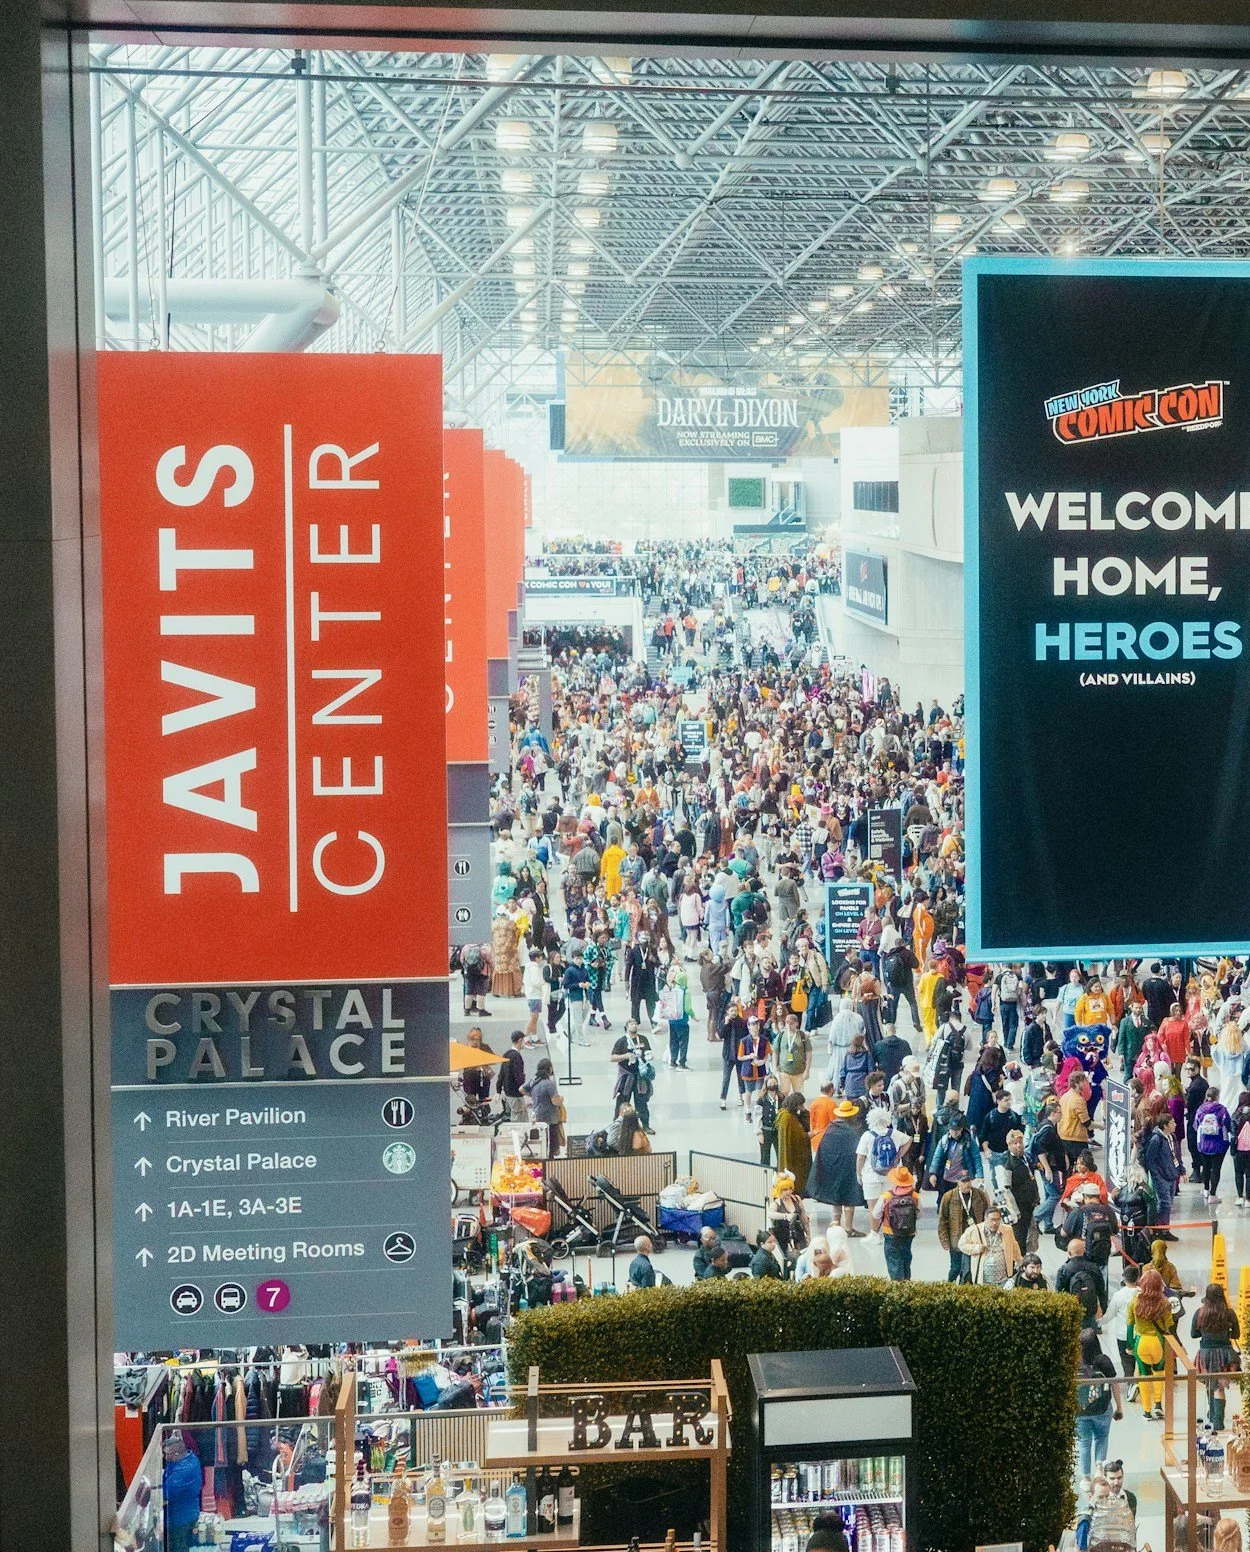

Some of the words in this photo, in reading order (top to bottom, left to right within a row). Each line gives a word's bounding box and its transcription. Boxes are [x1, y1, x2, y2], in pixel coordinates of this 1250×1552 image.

[656, 398, 729, 427] DARYL
[732, 398, 800, 428] DIXON
[1048, 393, 1078, 416] NEW
[1080, 383, 1118, 407] YORK
[1058, 393, 1156, 439] COMIC
[1159, 385, 1219, 423] CON
[677, 431, 698, 439] NOW
[699, 431, 750, 439] STREAMING
[679, 438, 735, 447] EXCLUSIVELY
[737, 438, 750, 447] ON
[558, 581, 577, 589] CON
[1053, 555, 1223, 602] HOME,
[1035, 620, 1243, 661] HEROES
[156, 443, 261, 896] JAVITS
[308, 440, 386, 897] CENTER
[1079, 671, 1119, 687] (AND
[1121, 671, 1197, 687] VILLAINS)
[145, 988, 406, 1035] CRYSTAL
[146, 1032, 406, 1080] PALACE
[166, 1109, 220, 1128] River
[226, 1107, 306, 1126] Pavilion
[166, 1153, 241, 1177] Crystal
[248, 1152, 317, 1170] Palace
[167, 1199, 232, 1220] 1A-1E,
[239, 1197, 303, 1216] 3A-3E
[168, 1246, 196, 1264] 2D
[203, 1243, 286, 1263] Meeting
[293, 1240, 365, 1258] Rooms
[266, 1287, 281, 1307] 7
[567, 1391, 714, 1451] BAR
